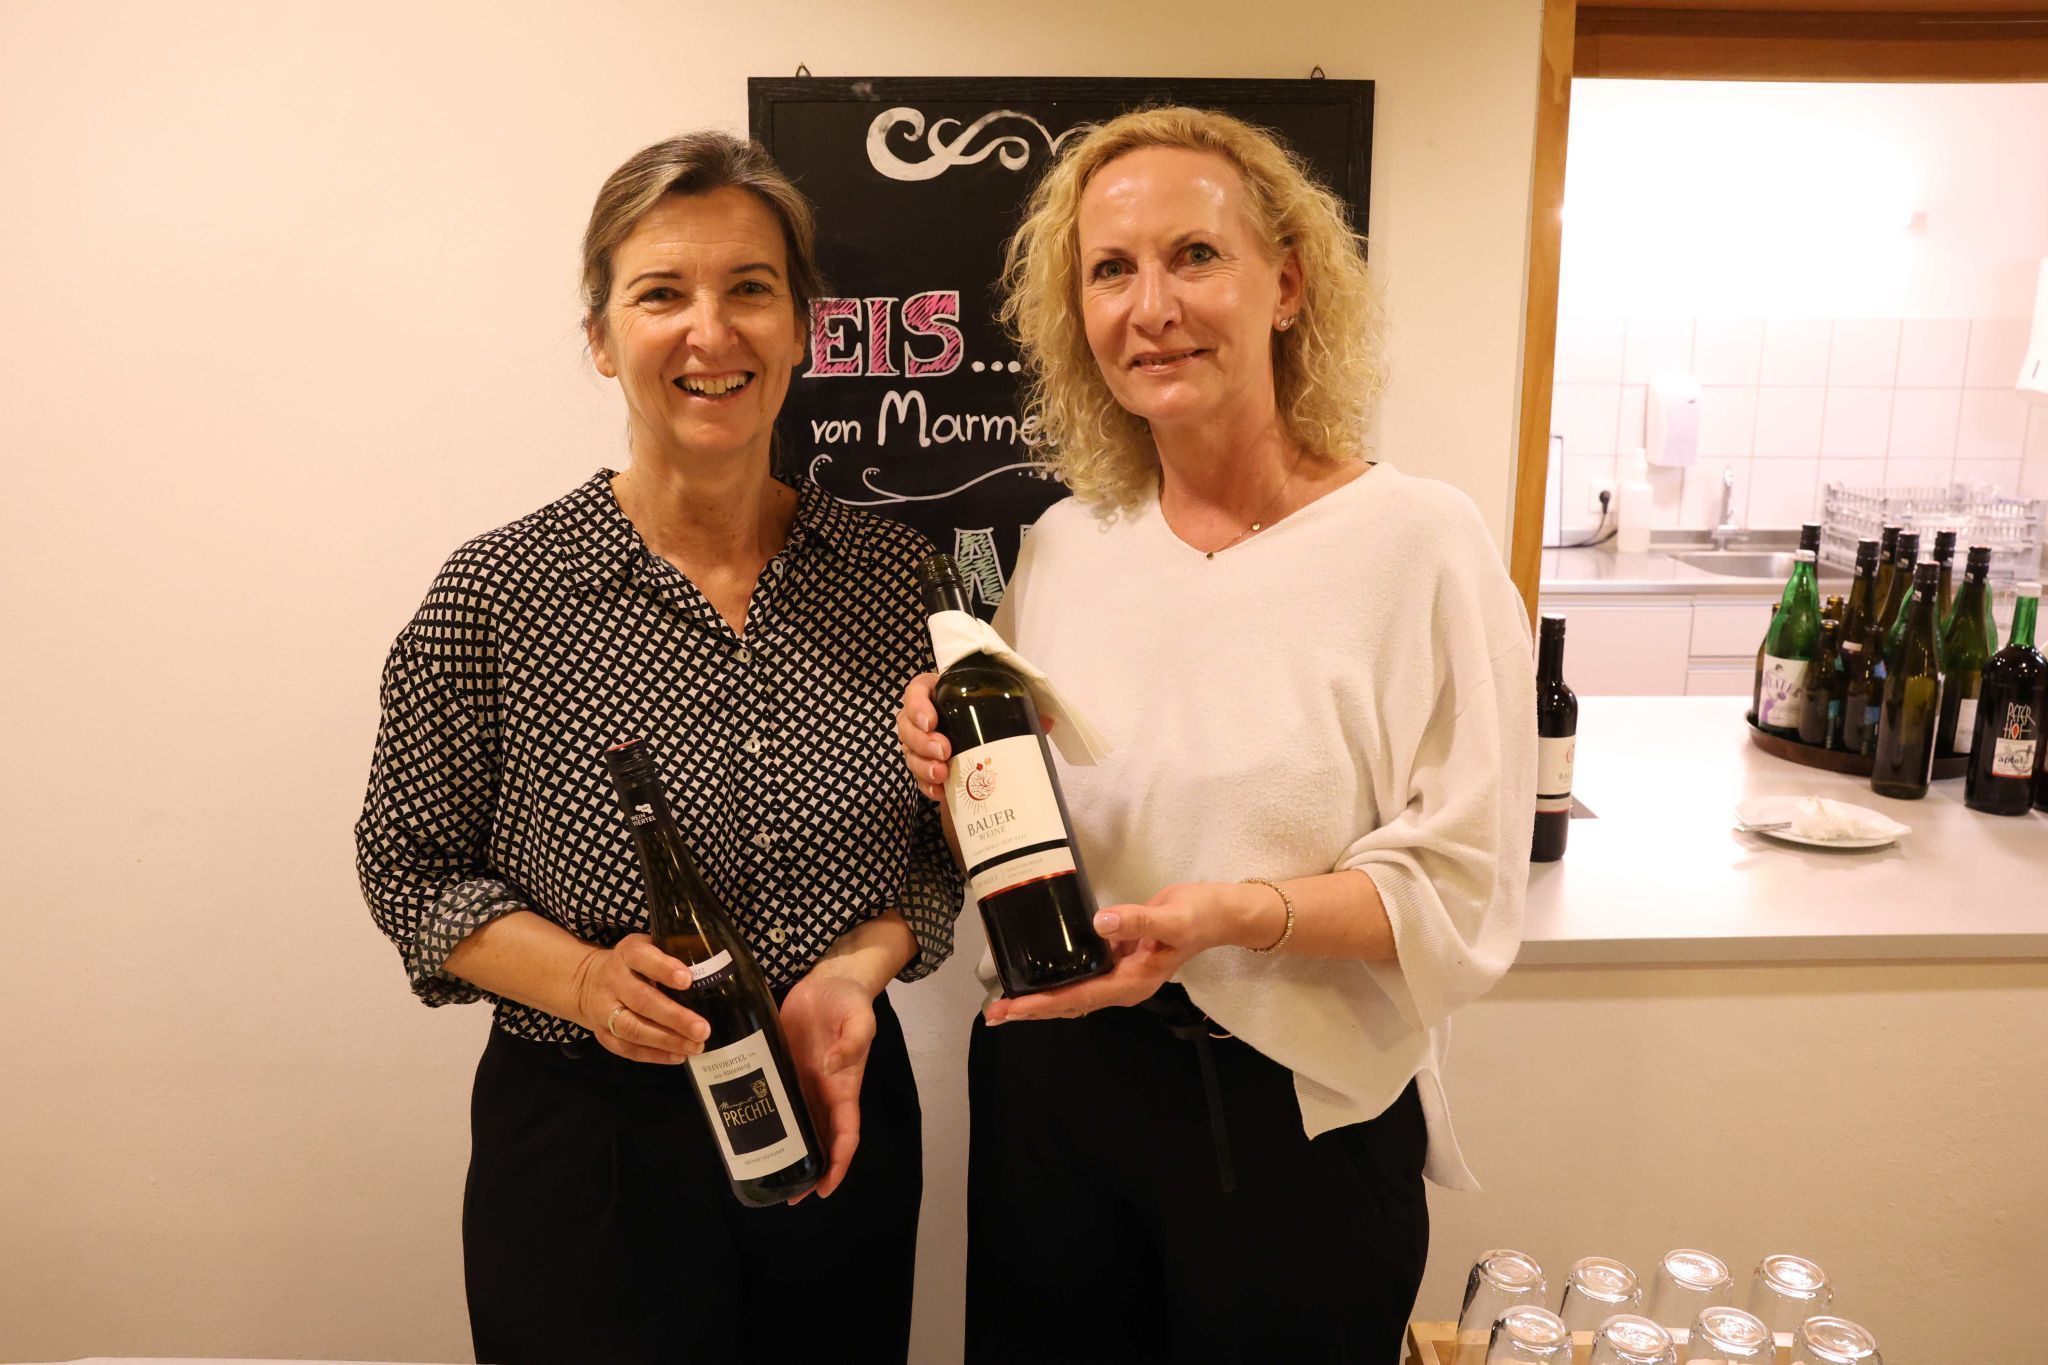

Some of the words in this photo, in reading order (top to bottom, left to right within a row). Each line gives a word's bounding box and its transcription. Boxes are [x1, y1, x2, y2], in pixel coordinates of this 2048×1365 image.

[811, 419, 862, 444] von
[877, 390, 1059, 447] Marme
[2006, 701, 2036, 726] PETER
[2003, 719, 2032, 741] HOF
[967, 808, 1016, 837] BAUER
[978, 825, 1006, 842] WEINE
[690, 967, 706, 977] 022
[723, 1098, 775, 1127] PRECHTL
